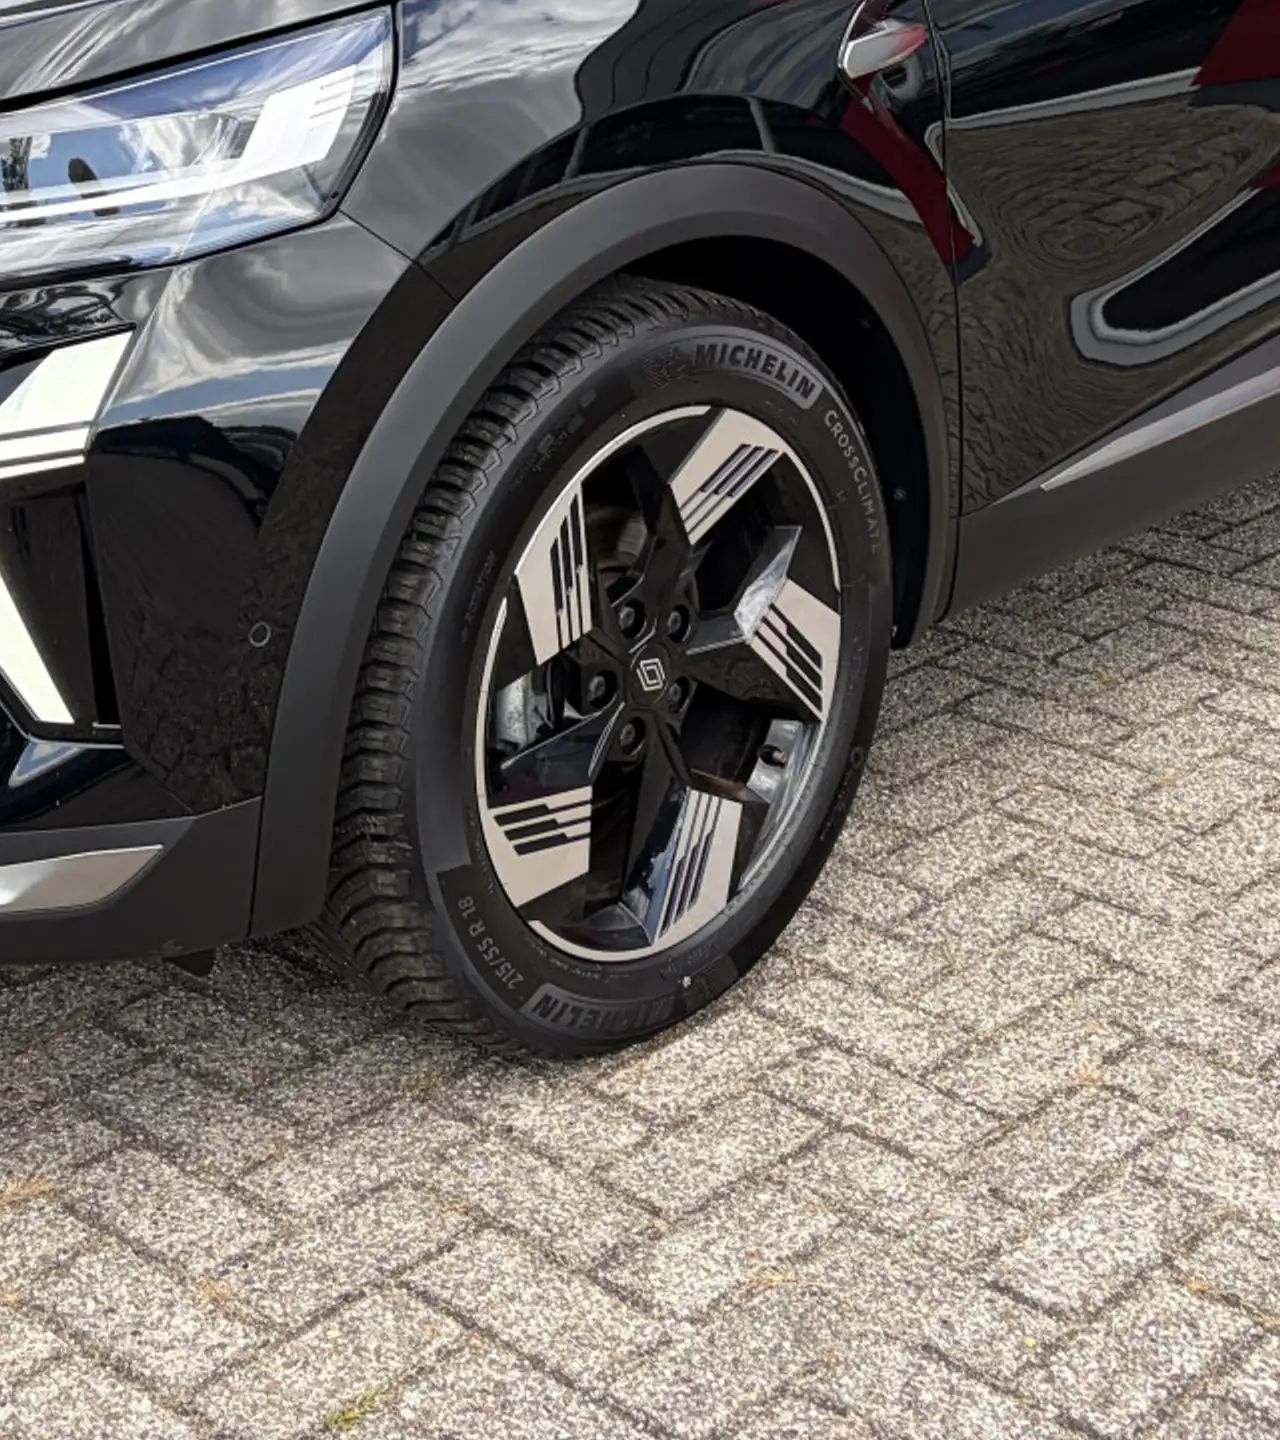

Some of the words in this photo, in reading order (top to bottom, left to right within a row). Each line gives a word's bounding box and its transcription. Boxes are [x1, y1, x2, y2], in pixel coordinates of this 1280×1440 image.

[694, 343, 817, 401] MICHELIN
[458, 895, 478, 918] 18
[475, 934, 525, 991] 215/55
